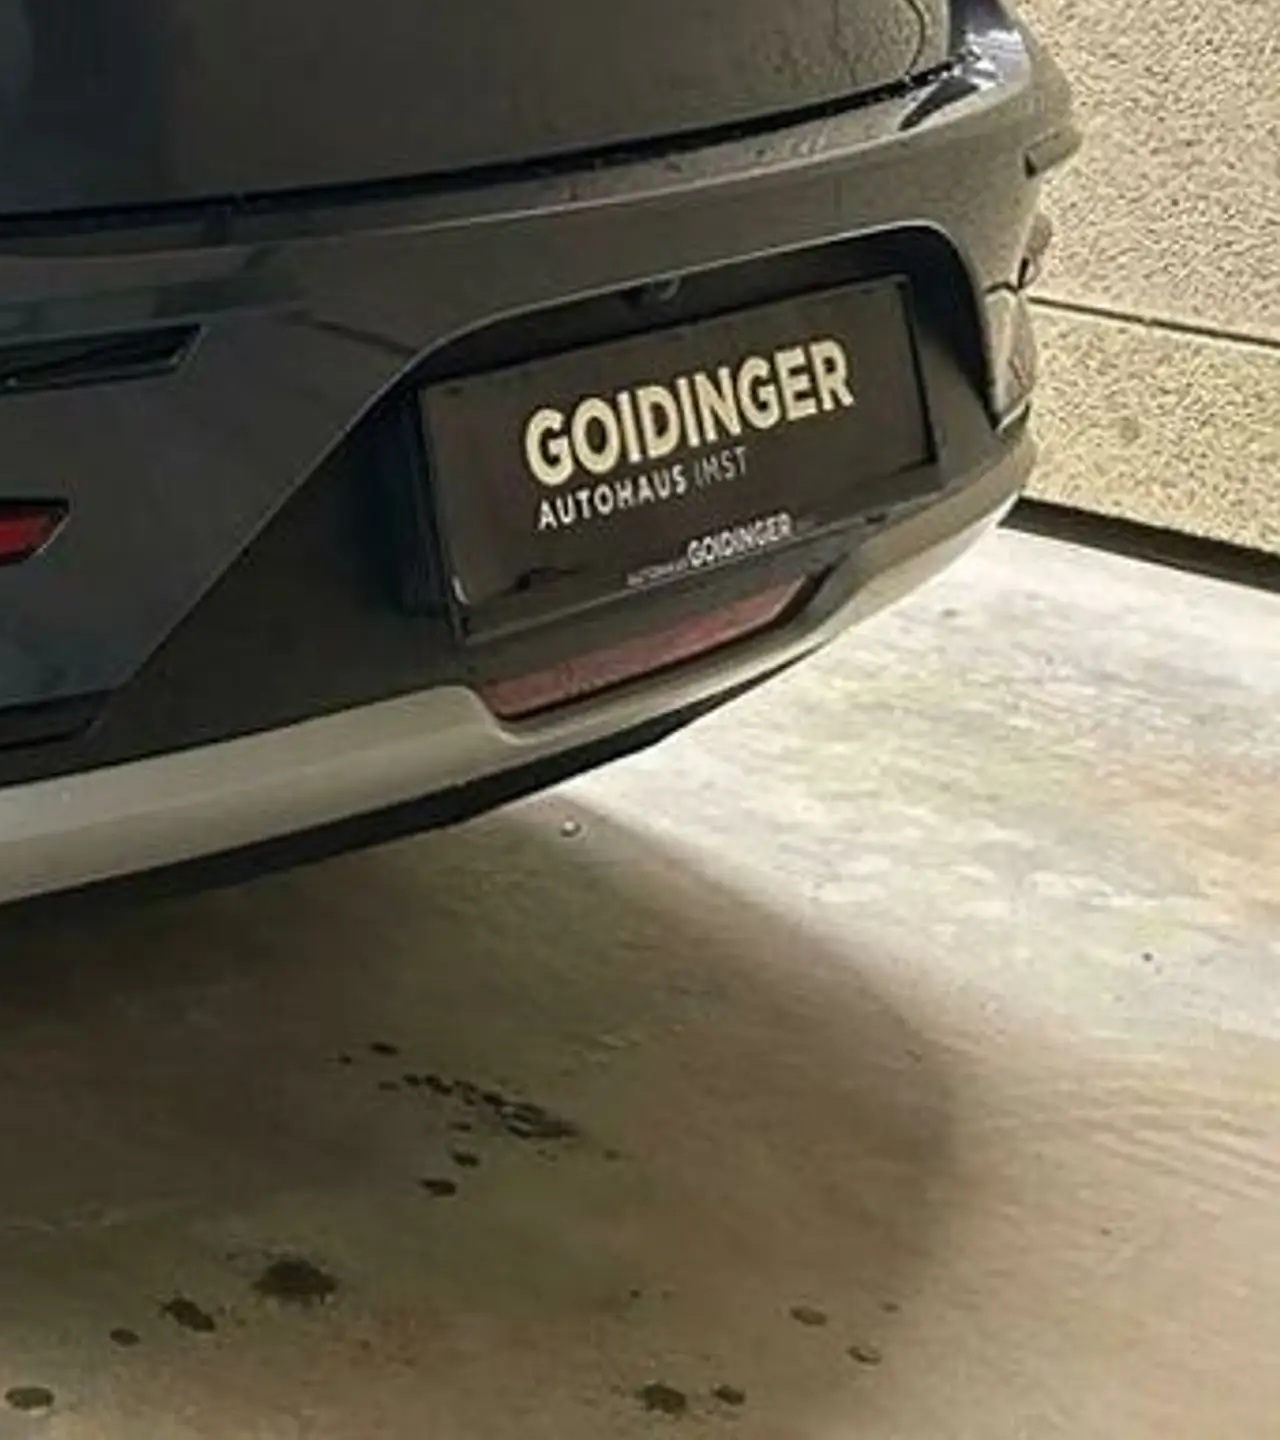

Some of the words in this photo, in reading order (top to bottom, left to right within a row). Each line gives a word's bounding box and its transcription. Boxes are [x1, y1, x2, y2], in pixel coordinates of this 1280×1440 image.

[525, 340, 854, 485] GOIDINGER
[538, 464, 687, 530] AUTOHAUS
[694, 446, 747, 488] IMST
[688, 512, 792, 568] GOIDINGER
